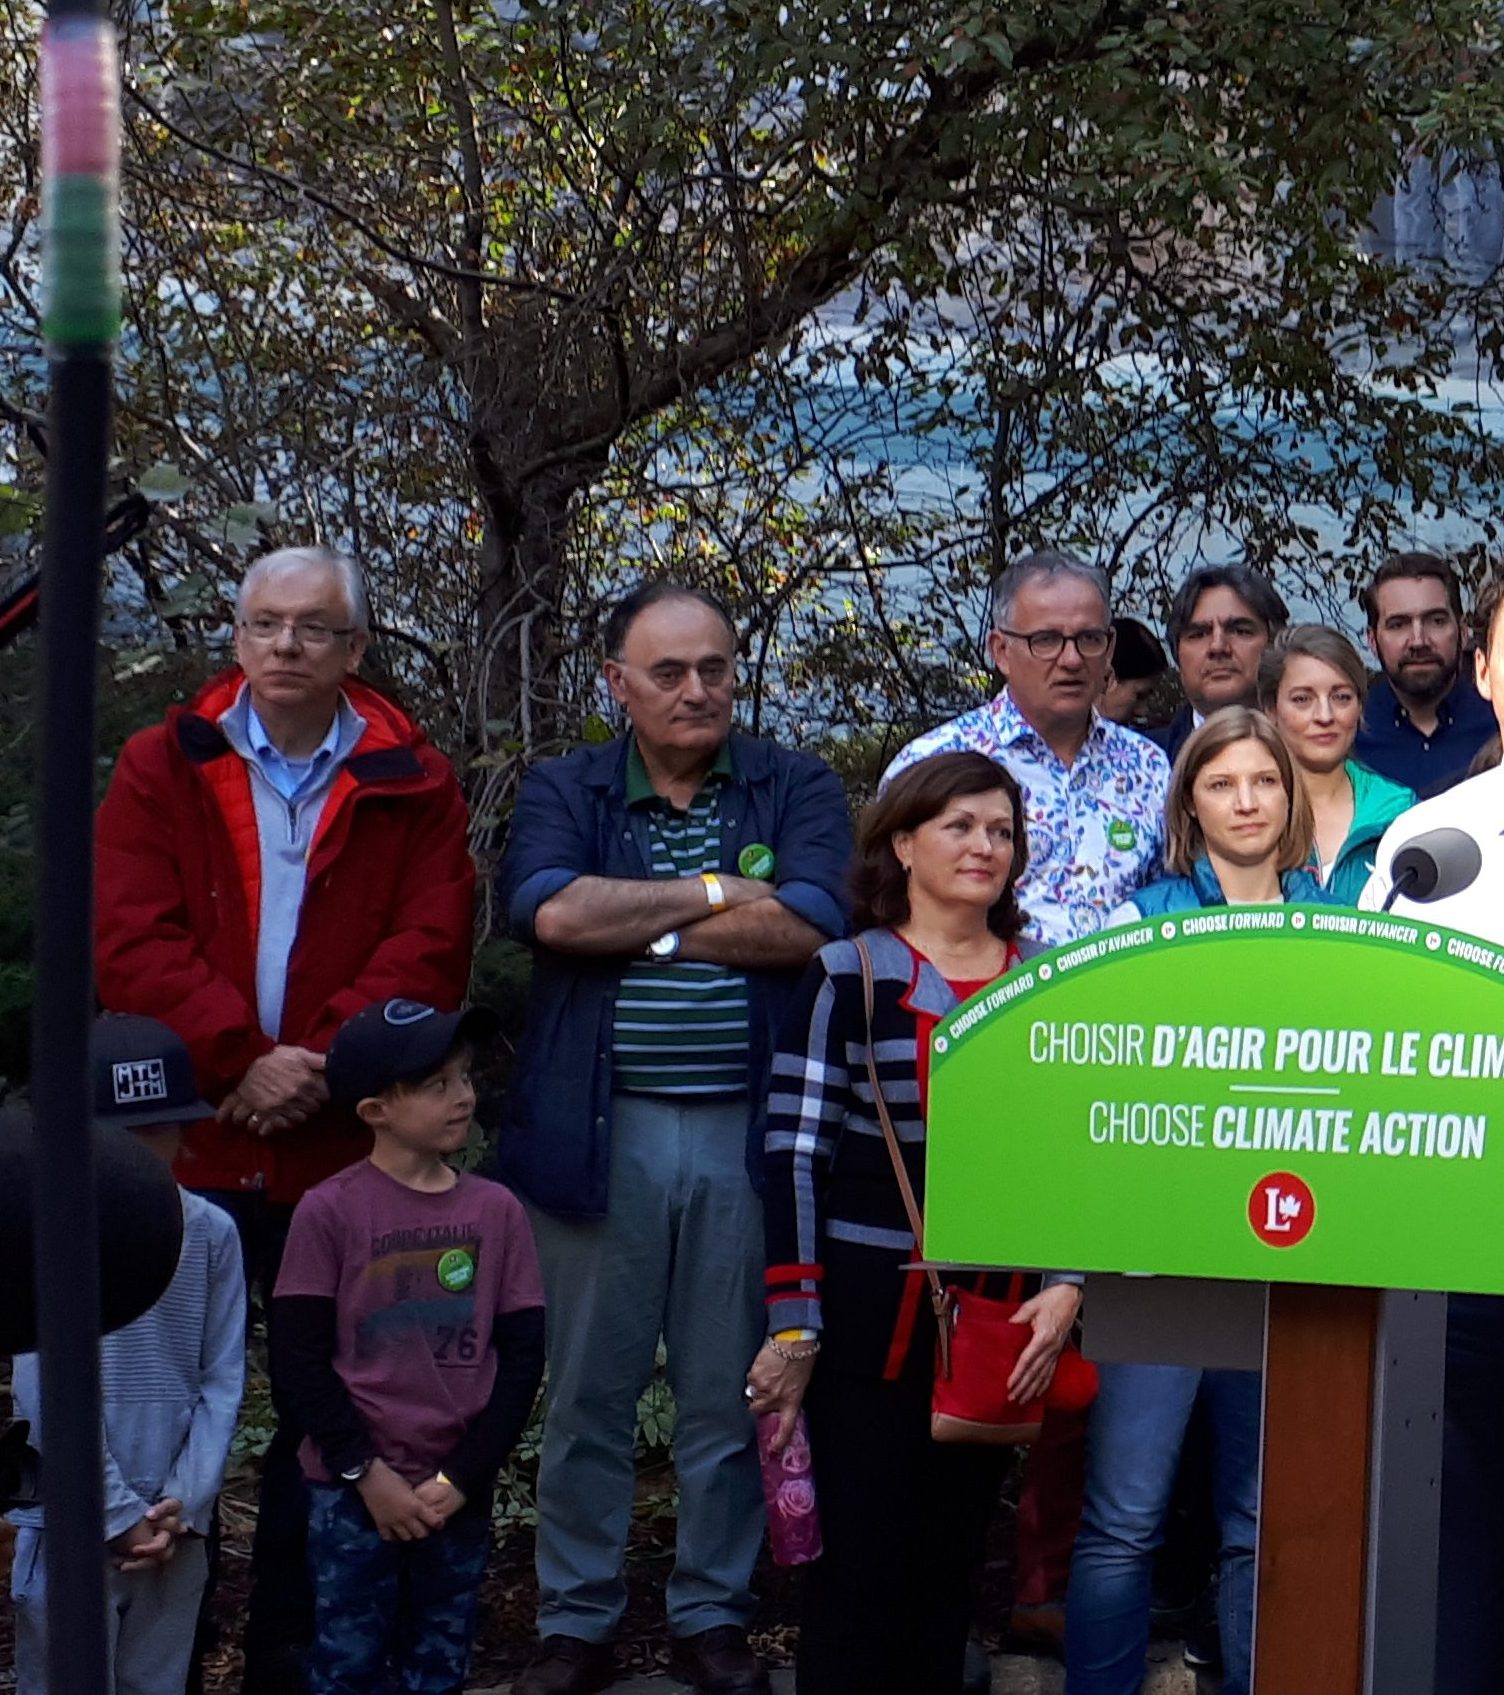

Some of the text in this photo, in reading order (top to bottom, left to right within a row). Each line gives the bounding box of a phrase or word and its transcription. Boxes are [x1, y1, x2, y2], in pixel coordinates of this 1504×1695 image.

[949, 1002, 989, 1040] CHOOSE
[986, 971, 1035, 1012] FORWARD
[1056, 943, 1099, 973] CHOISIR
[1098, 926, 1154, 957] D'AVANCER
[1182, 913, 1229, 936] CHOOSE
[1228, 911, 1285, 931] FORWARD
[1312, 913, 1357, 934] CHOISIR
[1357, 918, 1419, 945] D'AVANCER
[1447, 938, 1495, 970] CHOOSE
[1029, 1020, 1145, 1067] CHOISIR
[1151, 1023, 1266, 1071] D'AGIR
[1273, 1027, 1373, 1075] POUR
[1380, 1030, 1421, 1077] LE
[1089, 1100, 1487, 1160] CHOOSE CLIMATE ACTION
[433, 1325, 479, 1361] 76
